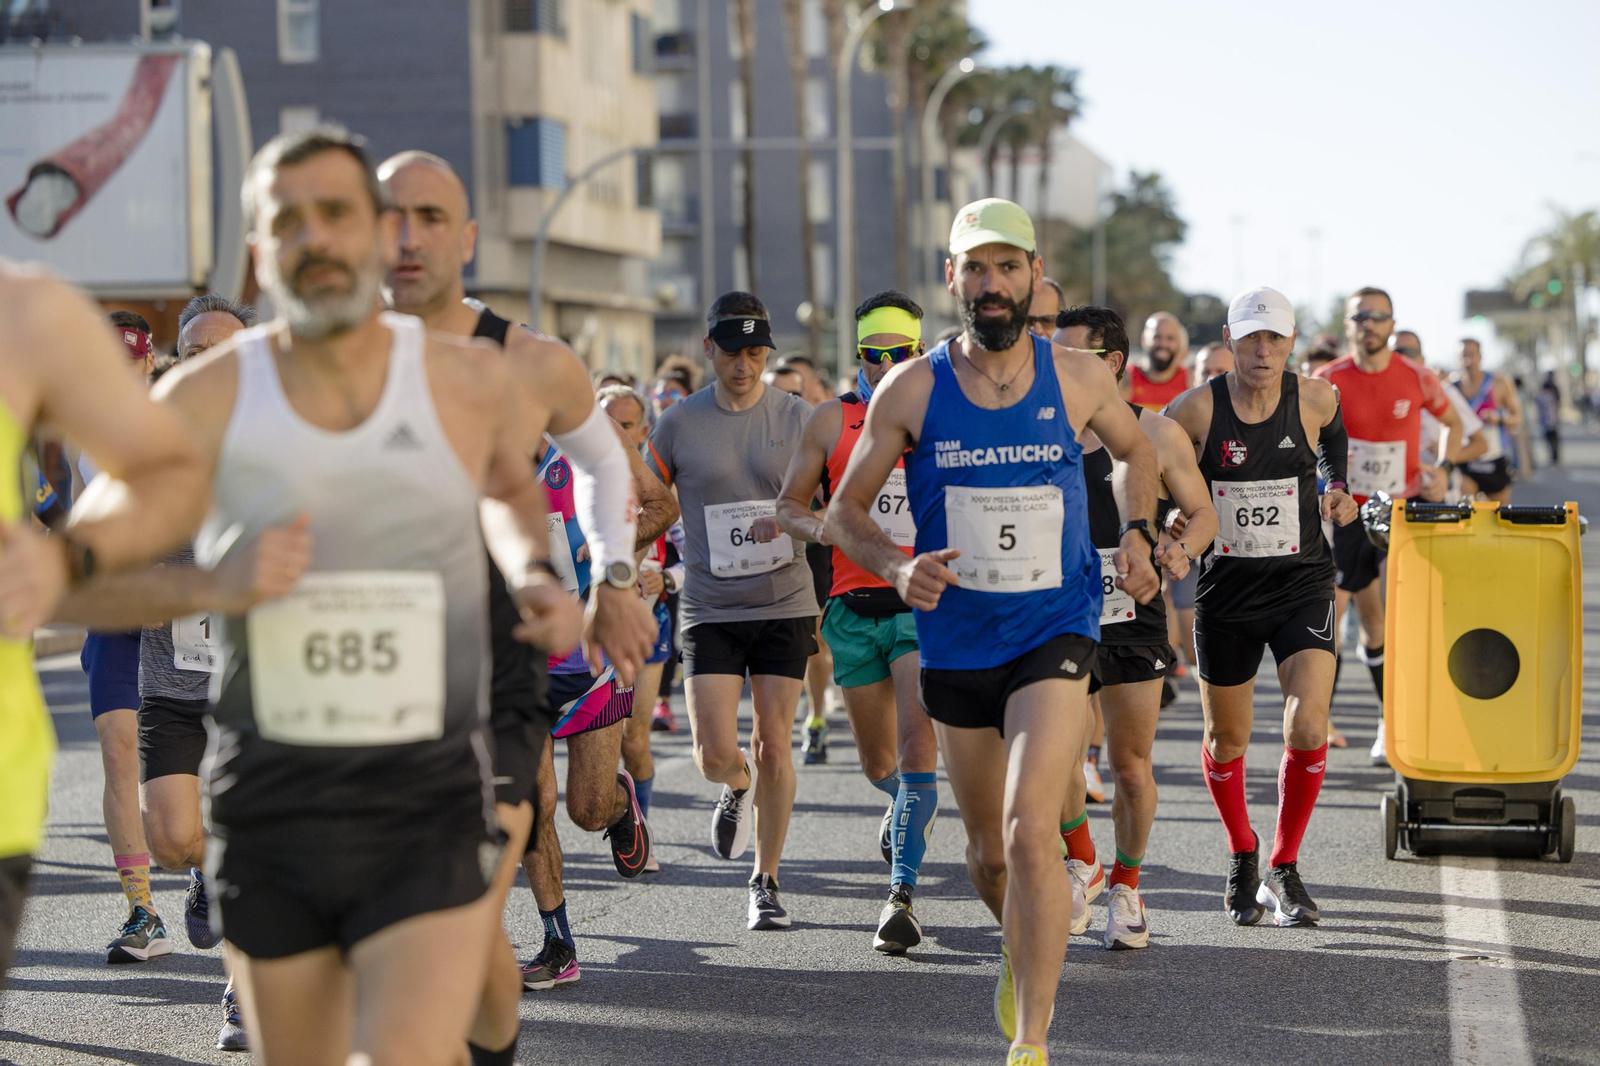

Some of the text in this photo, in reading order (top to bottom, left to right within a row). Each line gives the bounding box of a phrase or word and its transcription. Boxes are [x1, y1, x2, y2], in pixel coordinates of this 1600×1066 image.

[934, 440, 961, 451] TEAM
[935, 444, 1063, 468] MERCATUCHO
[1362, 461, 1391, 475] 407
[878, 494, 911, 515] 67
[1236, 506, 1279, 527] 652
[731, 526, 772, 546] 64
[998, 524, 1016, 551] 5
[305, 631, 399, 677] 685
